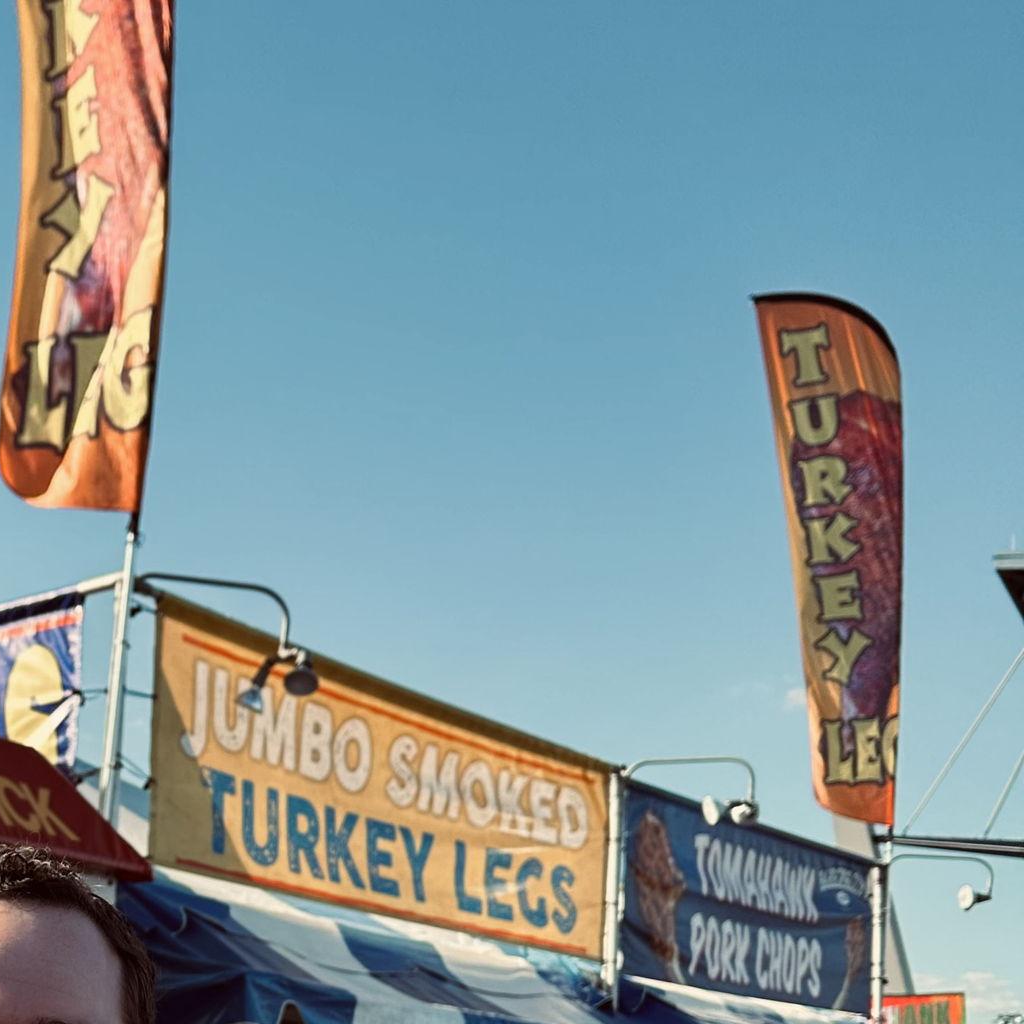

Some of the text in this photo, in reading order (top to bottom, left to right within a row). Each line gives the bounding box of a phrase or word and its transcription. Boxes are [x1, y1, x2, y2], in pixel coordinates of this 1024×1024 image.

[780, 323, 873, 686] TURKEY
[182, 659, 589, 849] JUMBO SMOKED
[204, 767, 577, 934] TURKEY LEGS
[694, 833, 819, 924] TOMAHAWK
[688, 912, 822, 998] PORK CHOPS
